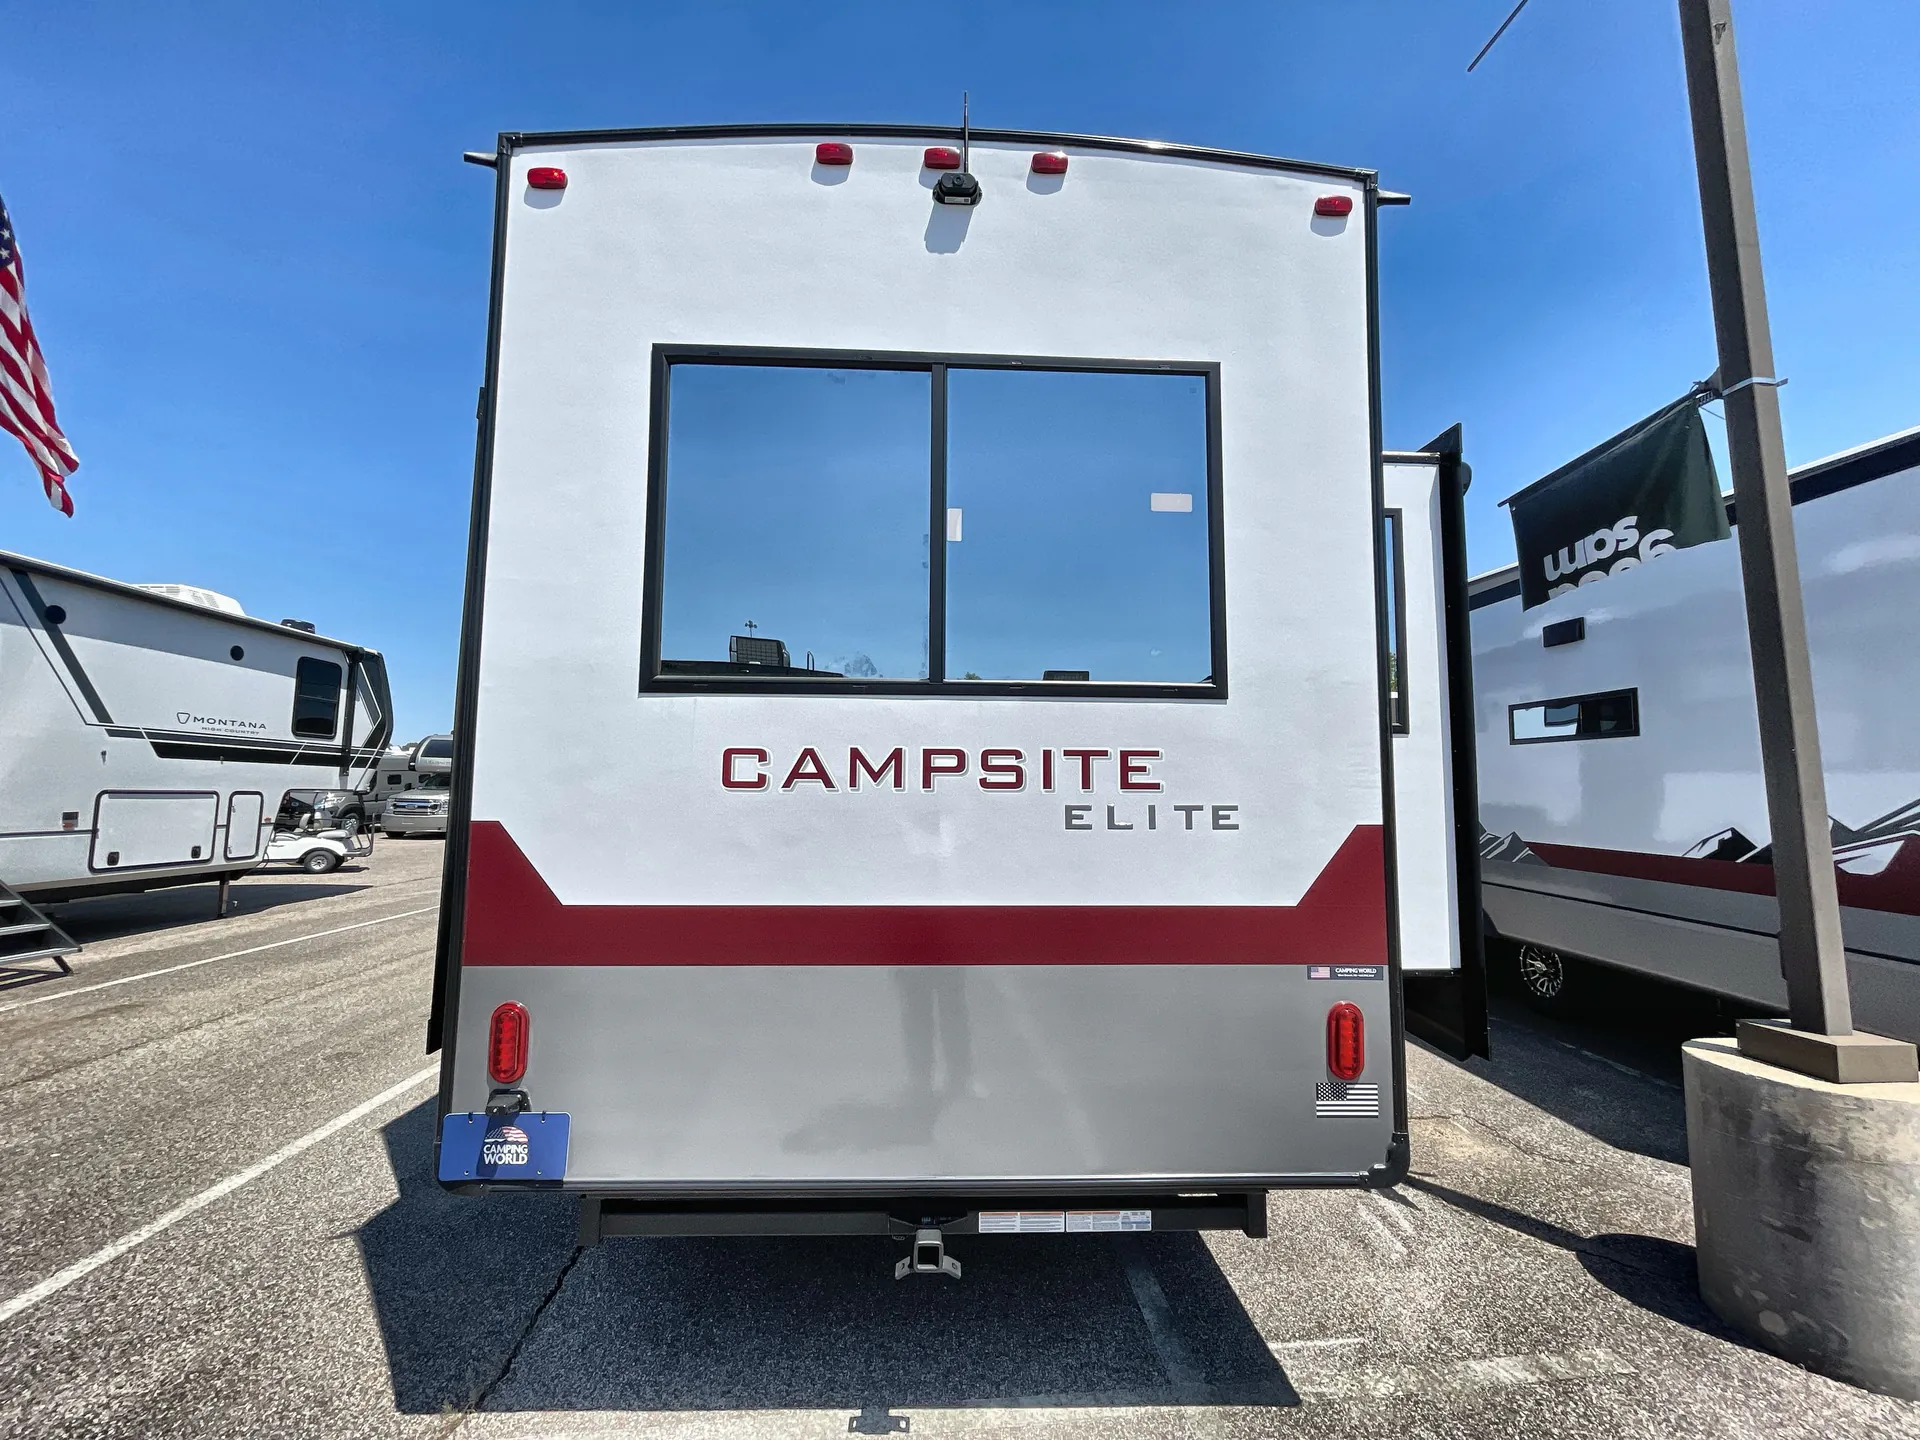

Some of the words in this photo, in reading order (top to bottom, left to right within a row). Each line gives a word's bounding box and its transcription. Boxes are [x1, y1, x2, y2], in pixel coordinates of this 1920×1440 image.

[193, 716, 267, 730] MONTANA
[721, 747, 1164, 793] CAMPSITE
[1064, 804, 1240, 831] ELITE
[483, 1144, 528, 1154] CAMPING
[483, 1153, 528, 1165] WORLD
